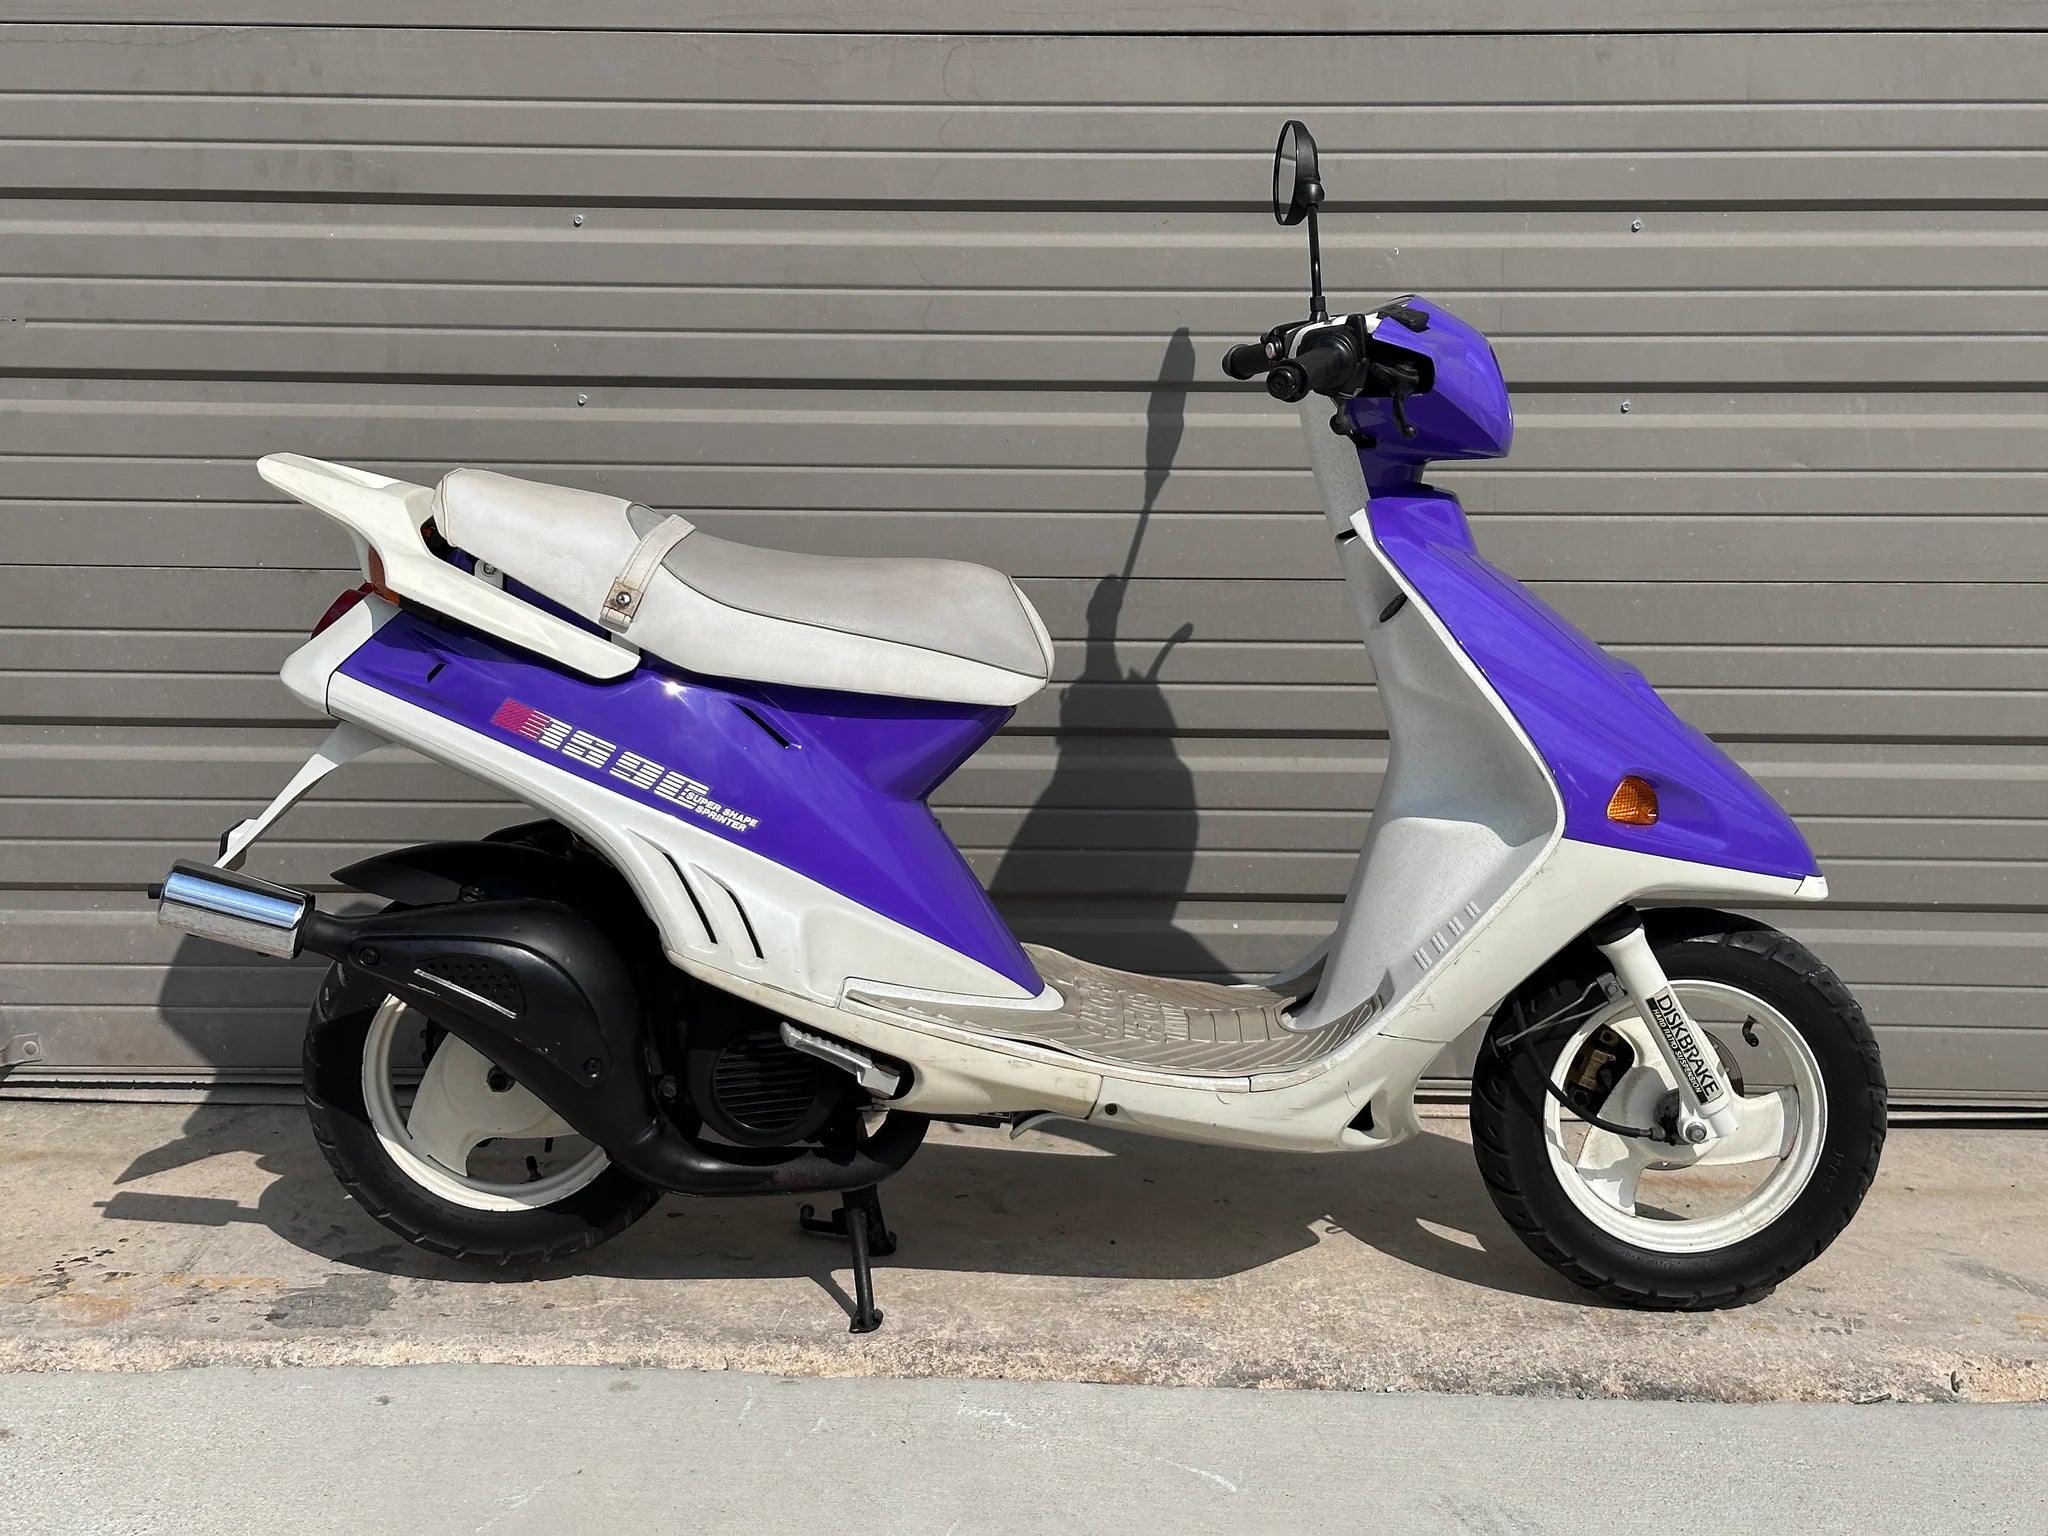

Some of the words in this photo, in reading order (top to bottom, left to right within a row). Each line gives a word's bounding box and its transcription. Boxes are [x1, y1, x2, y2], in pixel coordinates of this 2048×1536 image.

[686, 791, 722, 812] SUPER
[722, 808, 759, 828] SHAPE
[694, 805, 747, 832] SPRINTER
[1656, 995, 1719, 1097] DISKBRAKE
[1675, 1049, 1703, 1093] SUSPENSION
